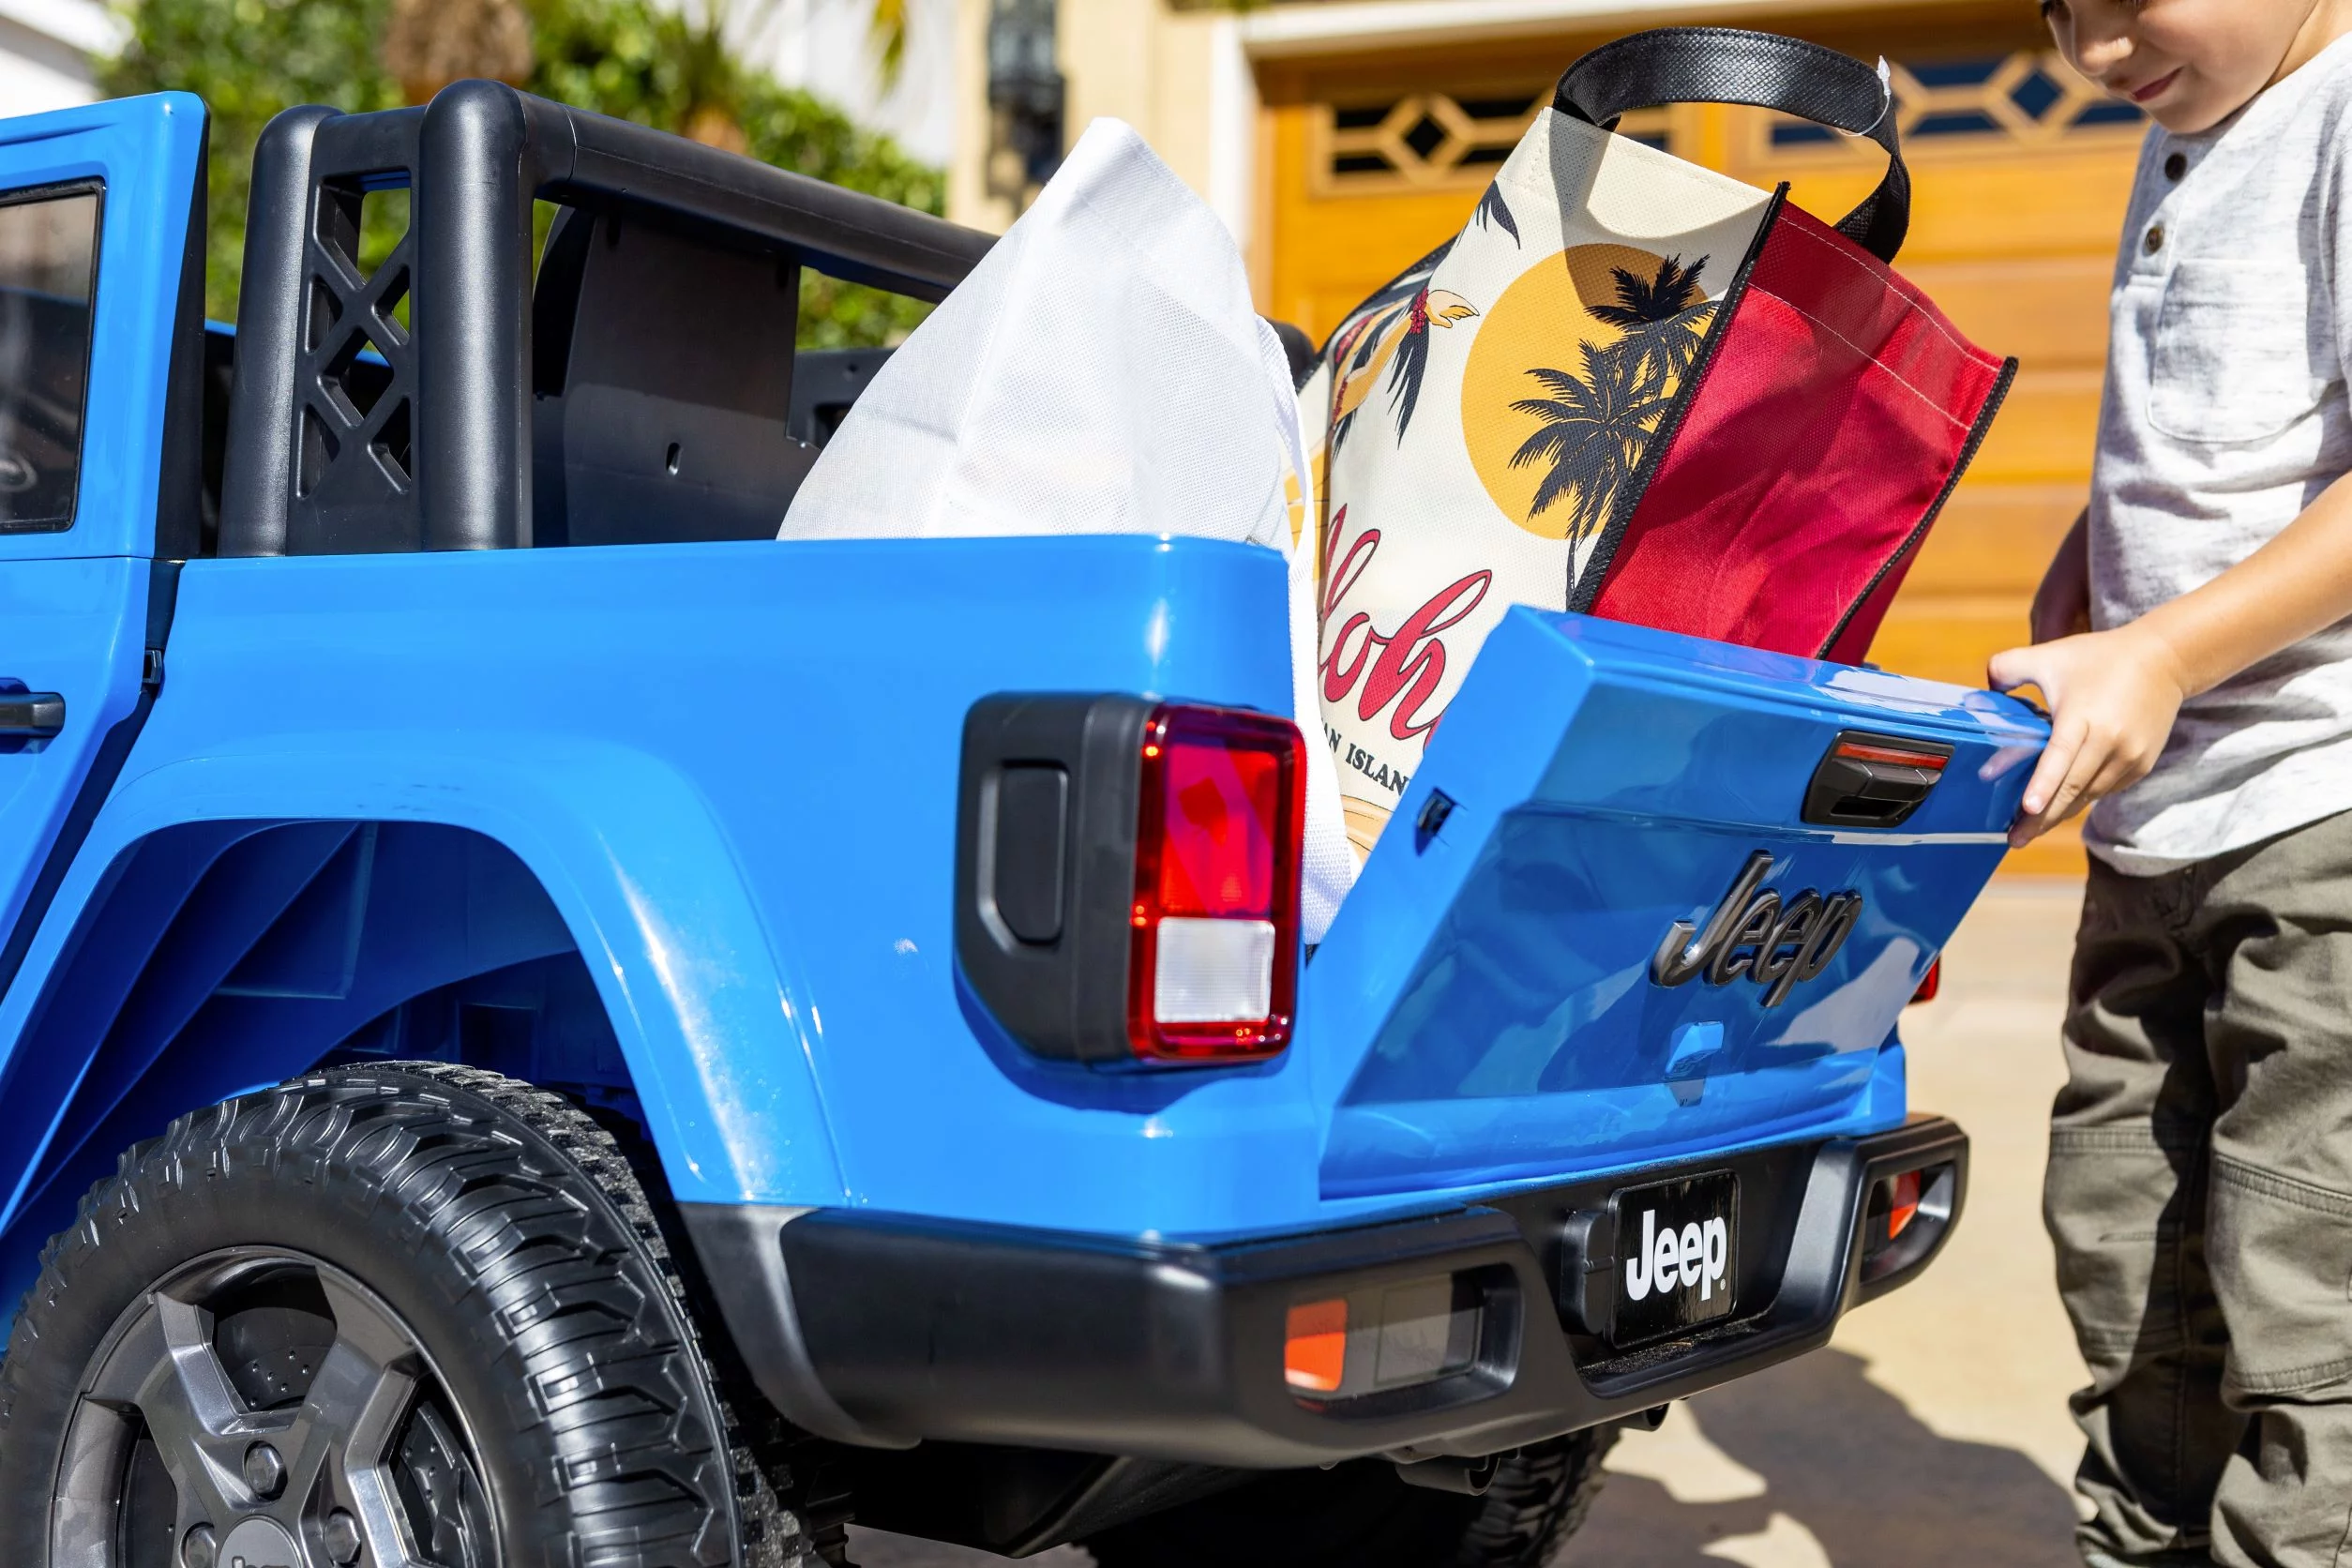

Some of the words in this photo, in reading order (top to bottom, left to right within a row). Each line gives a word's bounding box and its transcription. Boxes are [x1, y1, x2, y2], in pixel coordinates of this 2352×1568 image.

[1318, 503, 1492, 754] loh
[1346, 743, 1410, 796] ISLAN
[1650, 848, 1862, 1008] Jeep
[1626, 1209, 1727, 1302] Jeep
